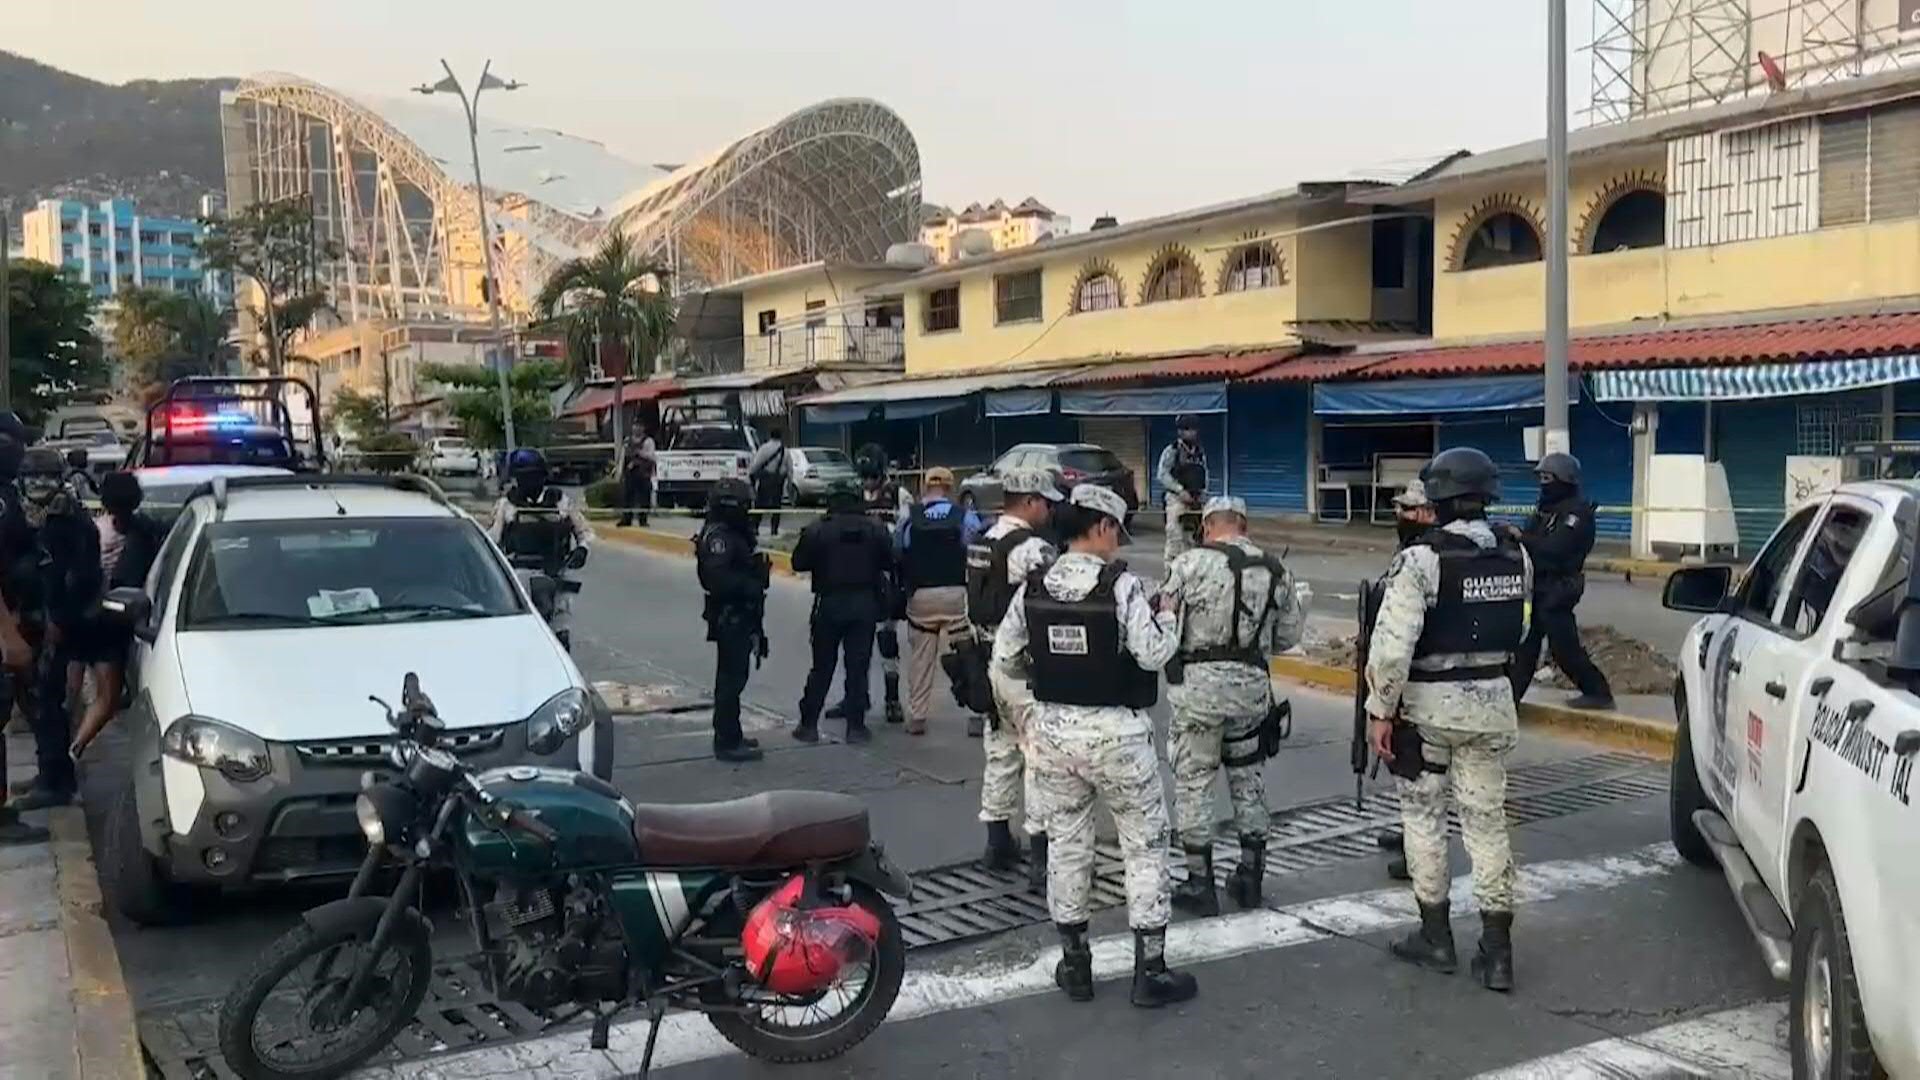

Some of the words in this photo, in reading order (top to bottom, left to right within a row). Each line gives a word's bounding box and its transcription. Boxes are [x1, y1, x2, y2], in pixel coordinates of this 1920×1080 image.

[1463, 575, 1522, 588] GUARDIA
[1463, 586, 1522, 599] NACIONAL
[1839, 719, 1911, 806] MINISTIAL
